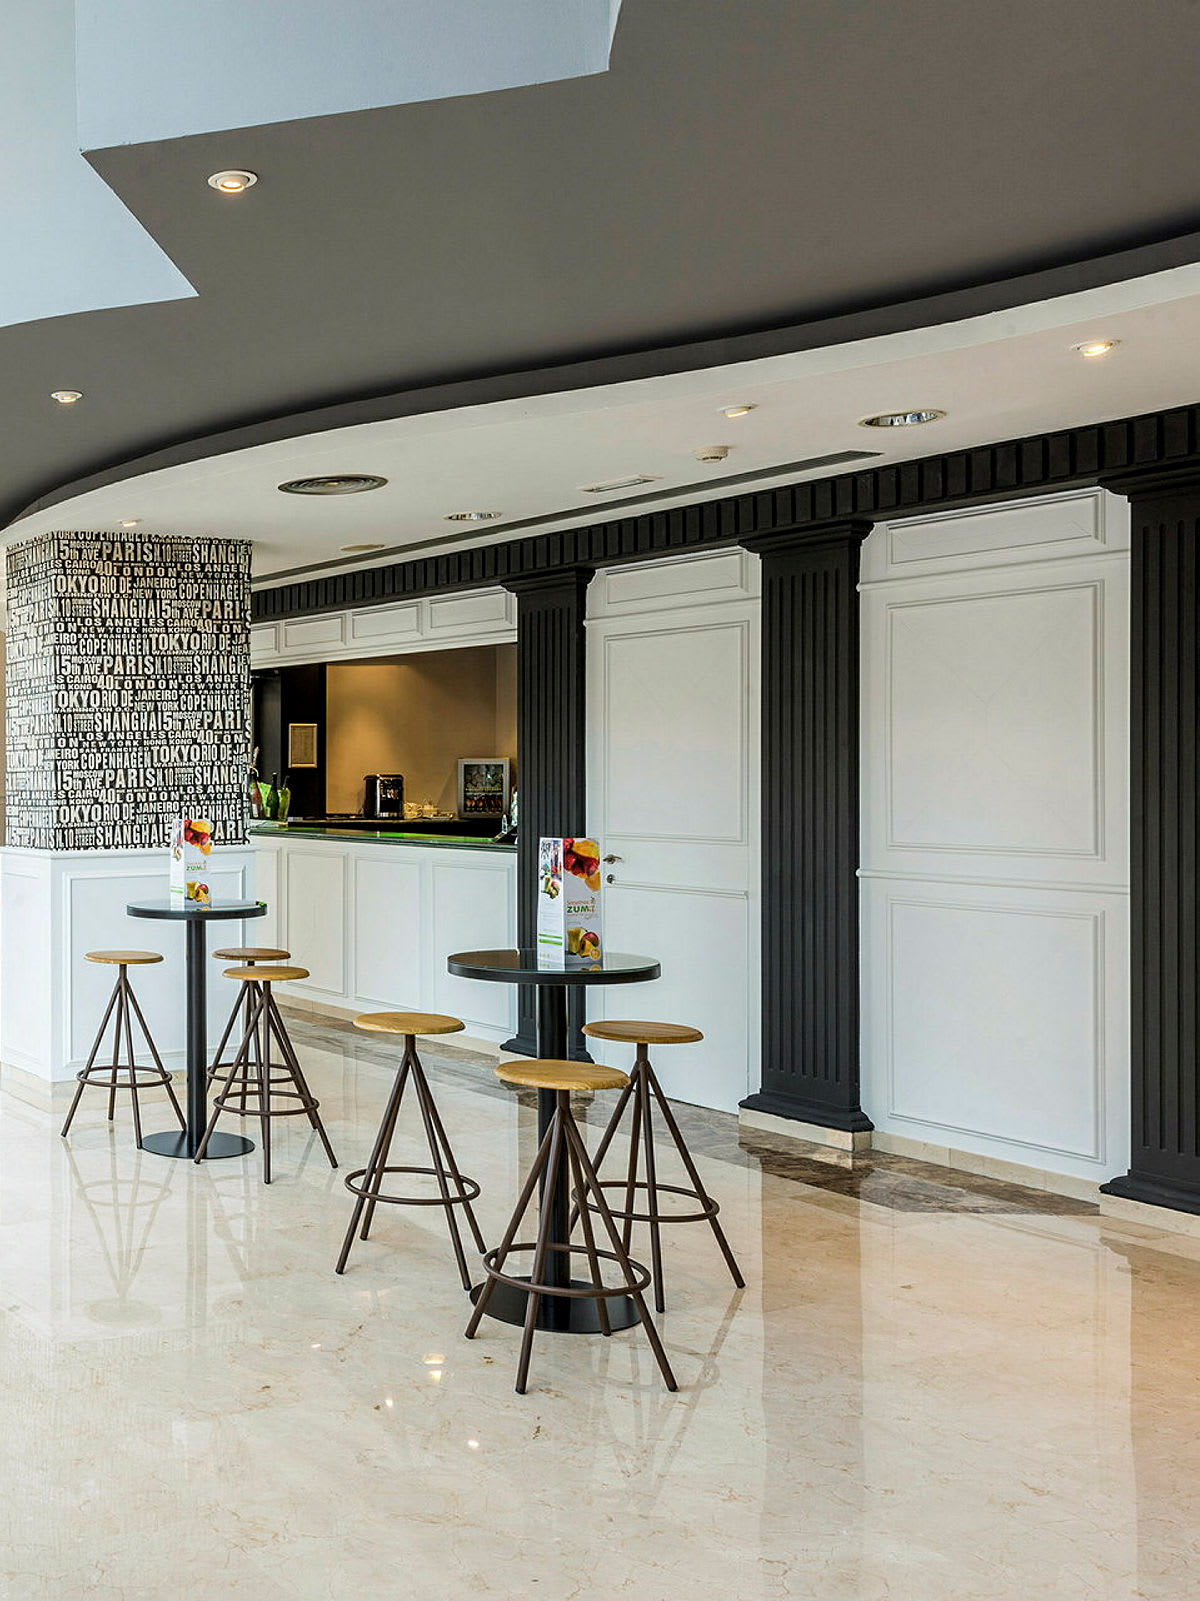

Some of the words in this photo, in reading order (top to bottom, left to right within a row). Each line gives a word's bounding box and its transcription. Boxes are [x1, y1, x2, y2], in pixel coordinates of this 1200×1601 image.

[70, 541, 101, 549] MOSCOW
[102, 541, 153, 562] PARIS
[65, 560, 96, 569] CAIRO
[95, 561, 112, 576] 40
[114, 567, 176, 577] LONDON
[51, 575, 99, 597] TOKYO
[101, 576, 116, 593] RIO
[120, 576, 132, 593] DE
[134, 578, 176, 588] JANEIRO
[133, 589, 153, 599] NEW
[156, 589, 177, 599] YORK
[93, 598, 160, 618] SHANGHAI
[77, 618, 102, 626] LOS
[106, 618, 164, 627] ANGELES
[167, 619, 197, 627] CAIRO
[197, 619, 212, 633] 40
[80, 639, 149, 655] COPENHAGEN
[149, 633, 200, 652] TOKYO
[202, 634, 216, 650] RIO
[219, 634, 231, 651] DE
[55, 645, 78, 655] YORK
[104, 656, 154, 674] PARIS
[67, 675, 98, 683] CAIRO
[97, 675, 113, 689] 40
[115, 680, 178, 689] LONDON
[178, 675, 201, 683] LOS
[52, 690, 100, 711] TOKYO
[102, 690, 118, 707] RIO
[121, 691, 133, 707] DE
[135, 690, 178, 701] JANEIRO
[134, 702, 154, 712] NEW
[157, 702, 179, 711] YORK
[95, 712, 162, 731] SHANGHAI
[107, 732, 166, 740] ANGELES
[197, 730, 213, 744] 40
[151, 744, 200, 762] TOKYO
[202, 744, 218, 761] RIO
[220, 744, 232, 761] DE
[57, 760, 79, 770] YORK
[81, 752, 151, 770] COPENHAGEN
[73, 770, 104, 778] MOSCOW
[105, 769, 155, 788] PARIS
[68, 789, 99, 798] CAIRO
[98, 789, 115, 804] 40
[117, 792, 179, 801] LONDON
[180, 785, 203, 794] LOS
[52, 804, 101, 823] TOKYO
[103, 804, 119, 821] RIO
[123, 803, 135, 820] DE
[136, 802, 179, 813] JANEIRO
[136, 814, 156, 824] NEW
[96, 825, 163, 844] SHANGHAI
